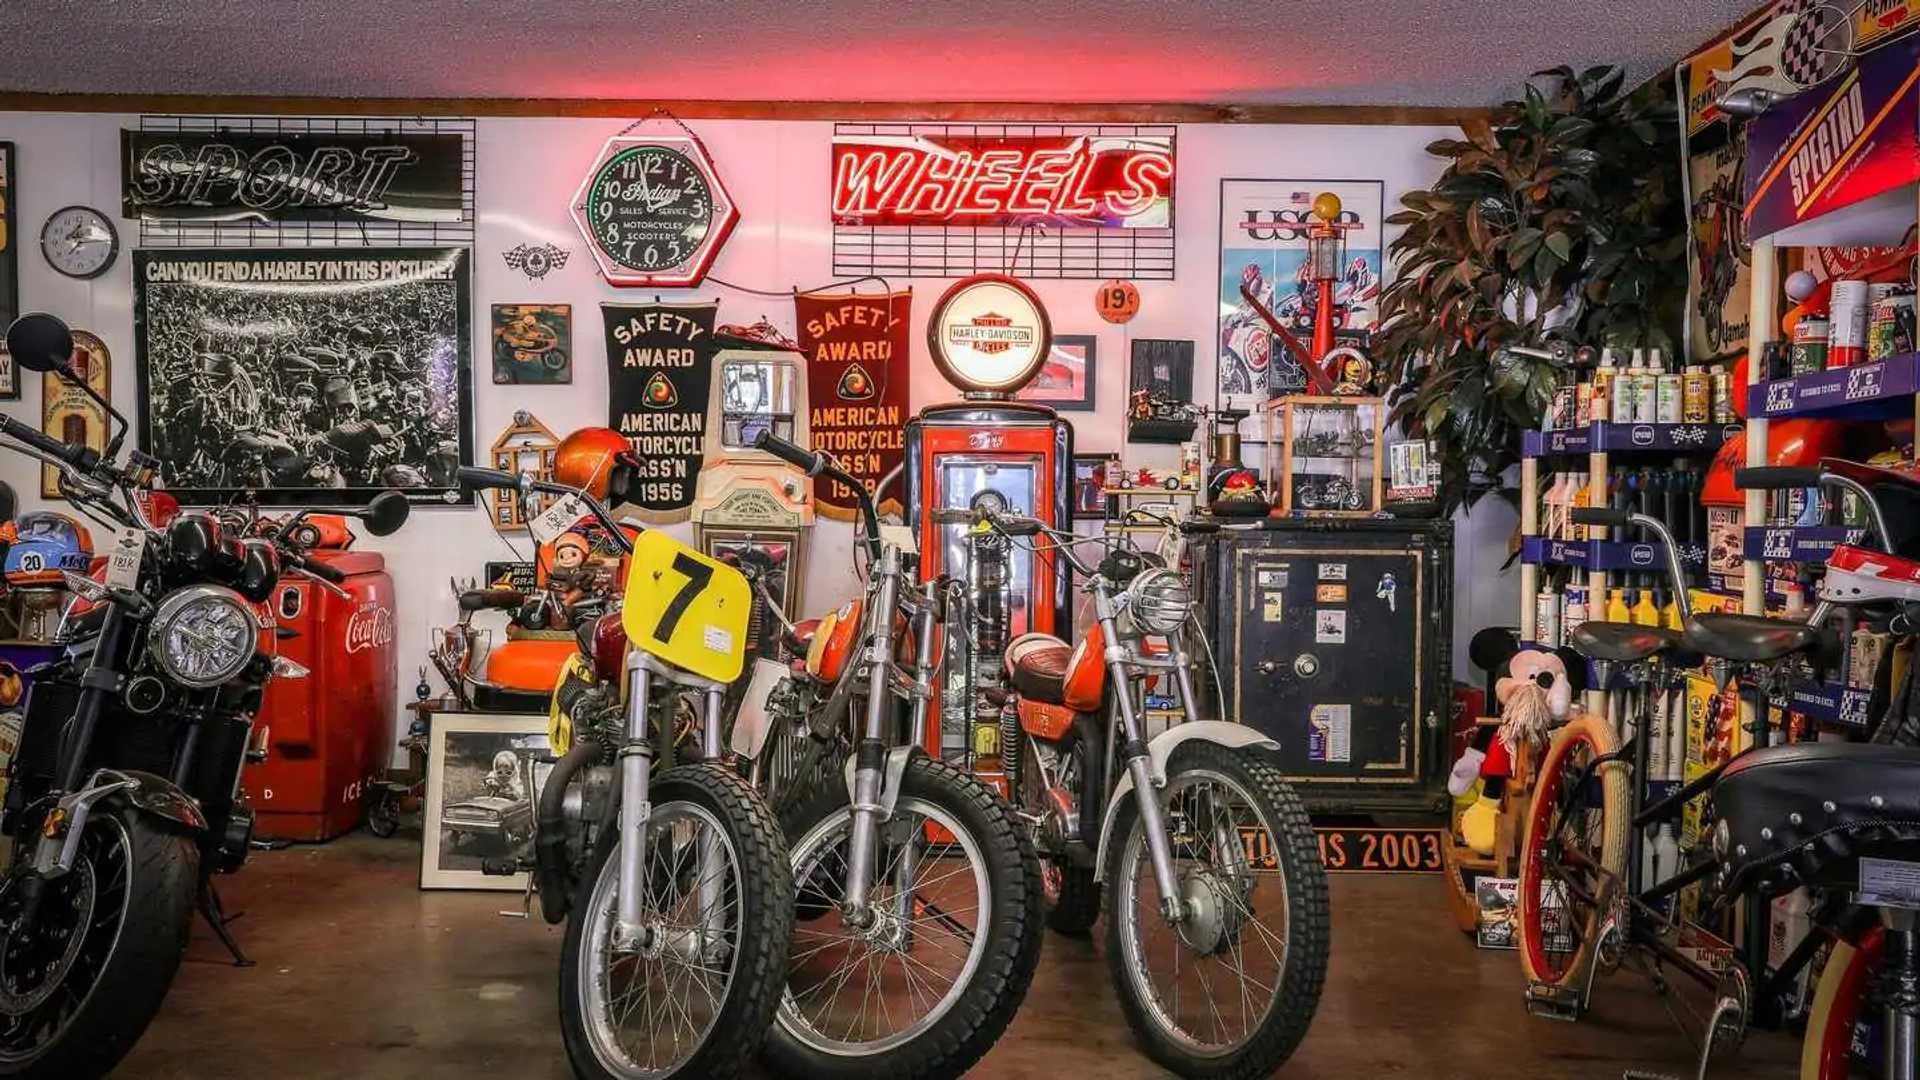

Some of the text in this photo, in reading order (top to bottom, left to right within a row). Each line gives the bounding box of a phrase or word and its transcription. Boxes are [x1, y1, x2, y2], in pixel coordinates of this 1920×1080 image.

[1789, 82, 1865, 207] SPECTRO
[644, 155, 664, 174] 12
[131, 144, 410, 210] SPORT
[683, 176, 698, 195] 2
[832, 150, 1173, 215] WHEELS
[603, 181, 621, 198] 10
[621, 181, 681, 201] Indian
[600, 201, 613, 222] 9
[620, 207, 688, 215] SALES SERVICE
[690, 199, 703, 218] 3
[607, 222, 619, 244] 8
[622, 241, 636, 260] 7
[644, 244, 658, 265] 6
[667, 241, 680, 261] 5
[146, 259, 456, 282] CAN YOU FIND A HARLEY IN THIS PICTURE?
[613, 312, 704, 345] SAFETY
[807, 305, 900, 339] SAFETY
[953, 328, 1030, 340] HARLEY-DAVIDSON
[623, 348, 695, 368] AWARD
[815, 341, 892, 361] AWARD
[620, 413, 701, 432] AMERICAN
[811, 406, 899, 427] AMERICAN
[638, 458, 686, 478] ASS'N
[640, 483, 683, 502] 1956
[24, 554, 41, 571] 20
[652, 551, 715, 645] 7
[346, 606, 392, 654] Coca-Cola
[1360, 834, 1441, 868] 2003
